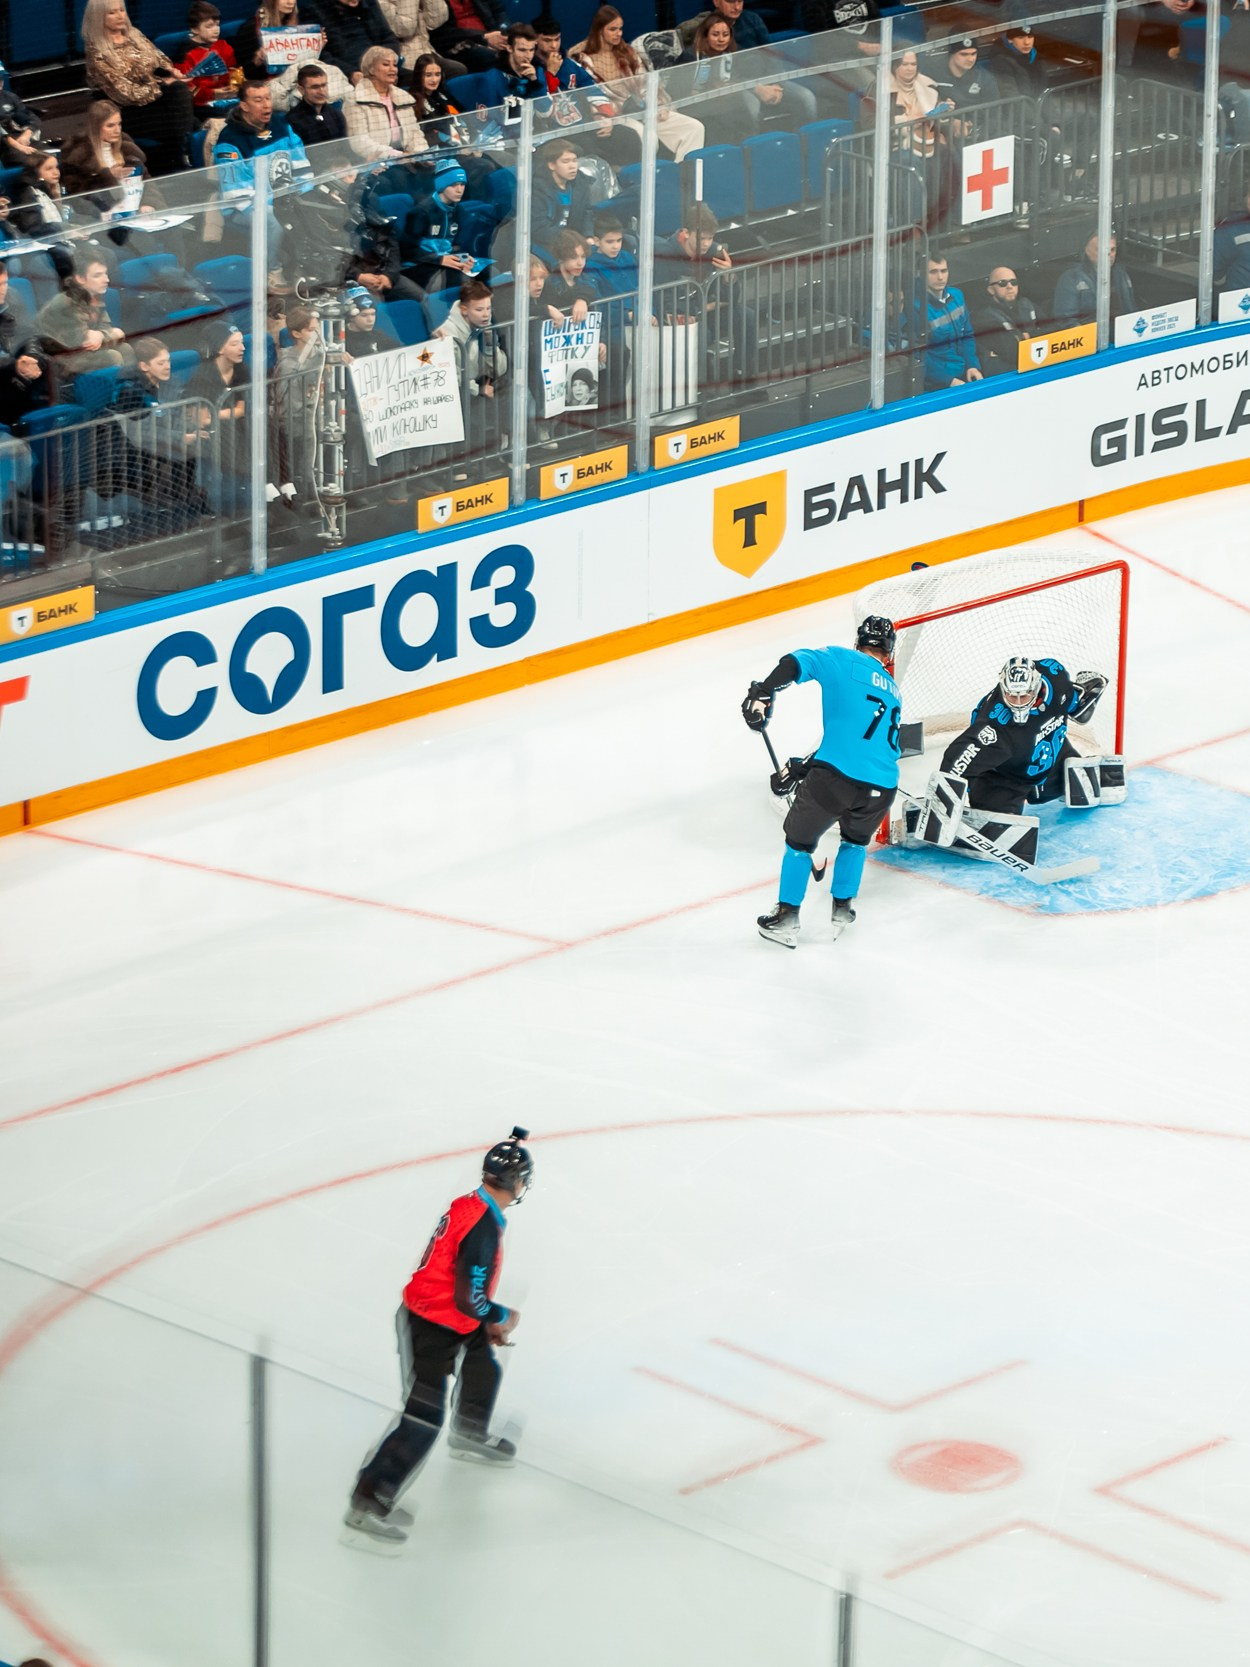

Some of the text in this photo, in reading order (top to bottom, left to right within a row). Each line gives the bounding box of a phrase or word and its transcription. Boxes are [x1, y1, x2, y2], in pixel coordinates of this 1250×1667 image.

[544, 332, 594, 351] МОЖНО
[1050, 336, 1084, 355] БАНК
[392, 413, 438, 438] КЛЮШКУ
[690, 429, 726, 449] БАНК
[576, 459, 613, 480] БАНК
[455, 492, 494, 512] БАНК
[733, 450, 948, 549] Т БАНК
[36, 602, 79, 623] БАНК
[872, 671, 902, 700] GUT
[862, 694, 901, 753] 78
[988, 702, 1012, 725] 30
